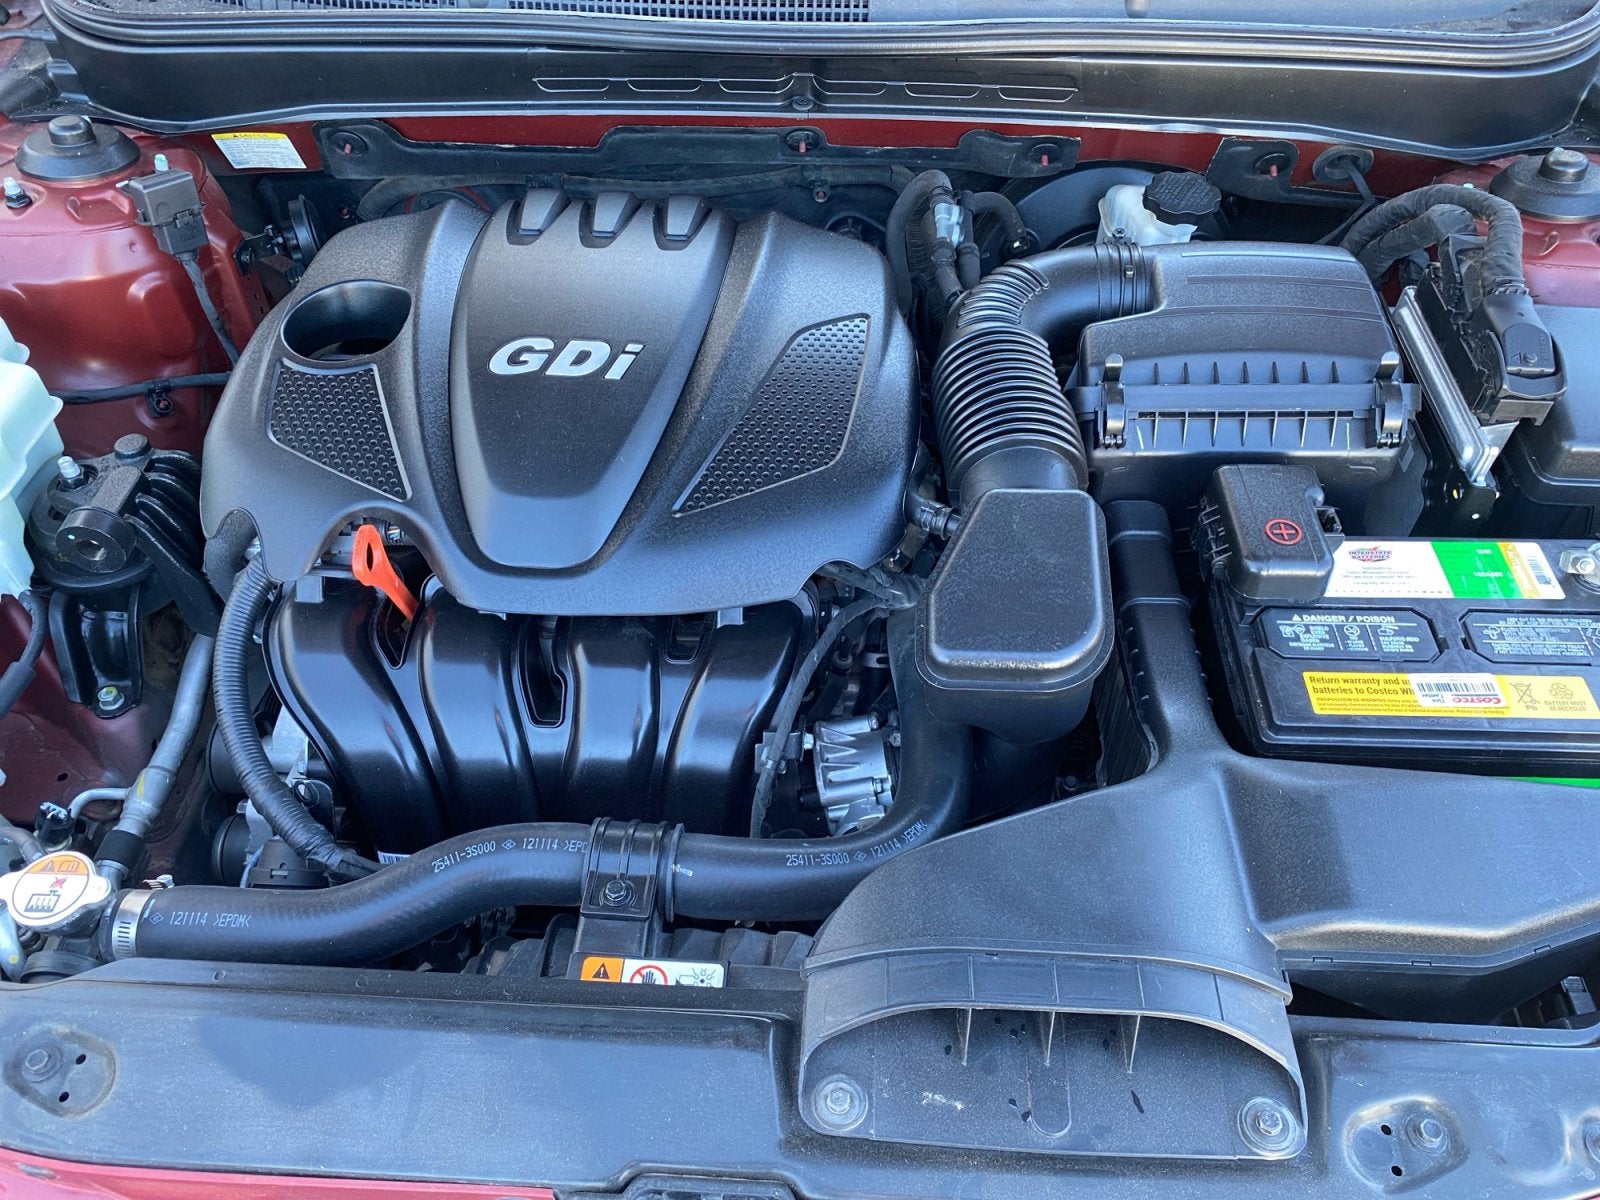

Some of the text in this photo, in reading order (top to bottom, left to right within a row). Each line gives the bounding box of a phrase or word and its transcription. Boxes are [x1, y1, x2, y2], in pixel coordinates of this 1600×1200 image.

[488, 337, 645, 380] GDi
[1302, 614, 1346, 623] DANGER
[1357, 615, 1395, 623] POISON
[1309, 676, 1341, 684] Return
[1342, 676, 1381, 686] warranty
[1383, 677, 1400, 685] and
[1312, 686, 1353, 694] batteries
[1355, 686, 1365, 694] to
[1366, 687, 1399, 695] Costco
[431, 840, 496, 873] 25411-3S000
[523, 838, 558, 850] 121114
[786, 854, 849, 866] 25411-3S000
[871, 838, 900, 859] 121114
[169, 911, 207, 926] 121114
